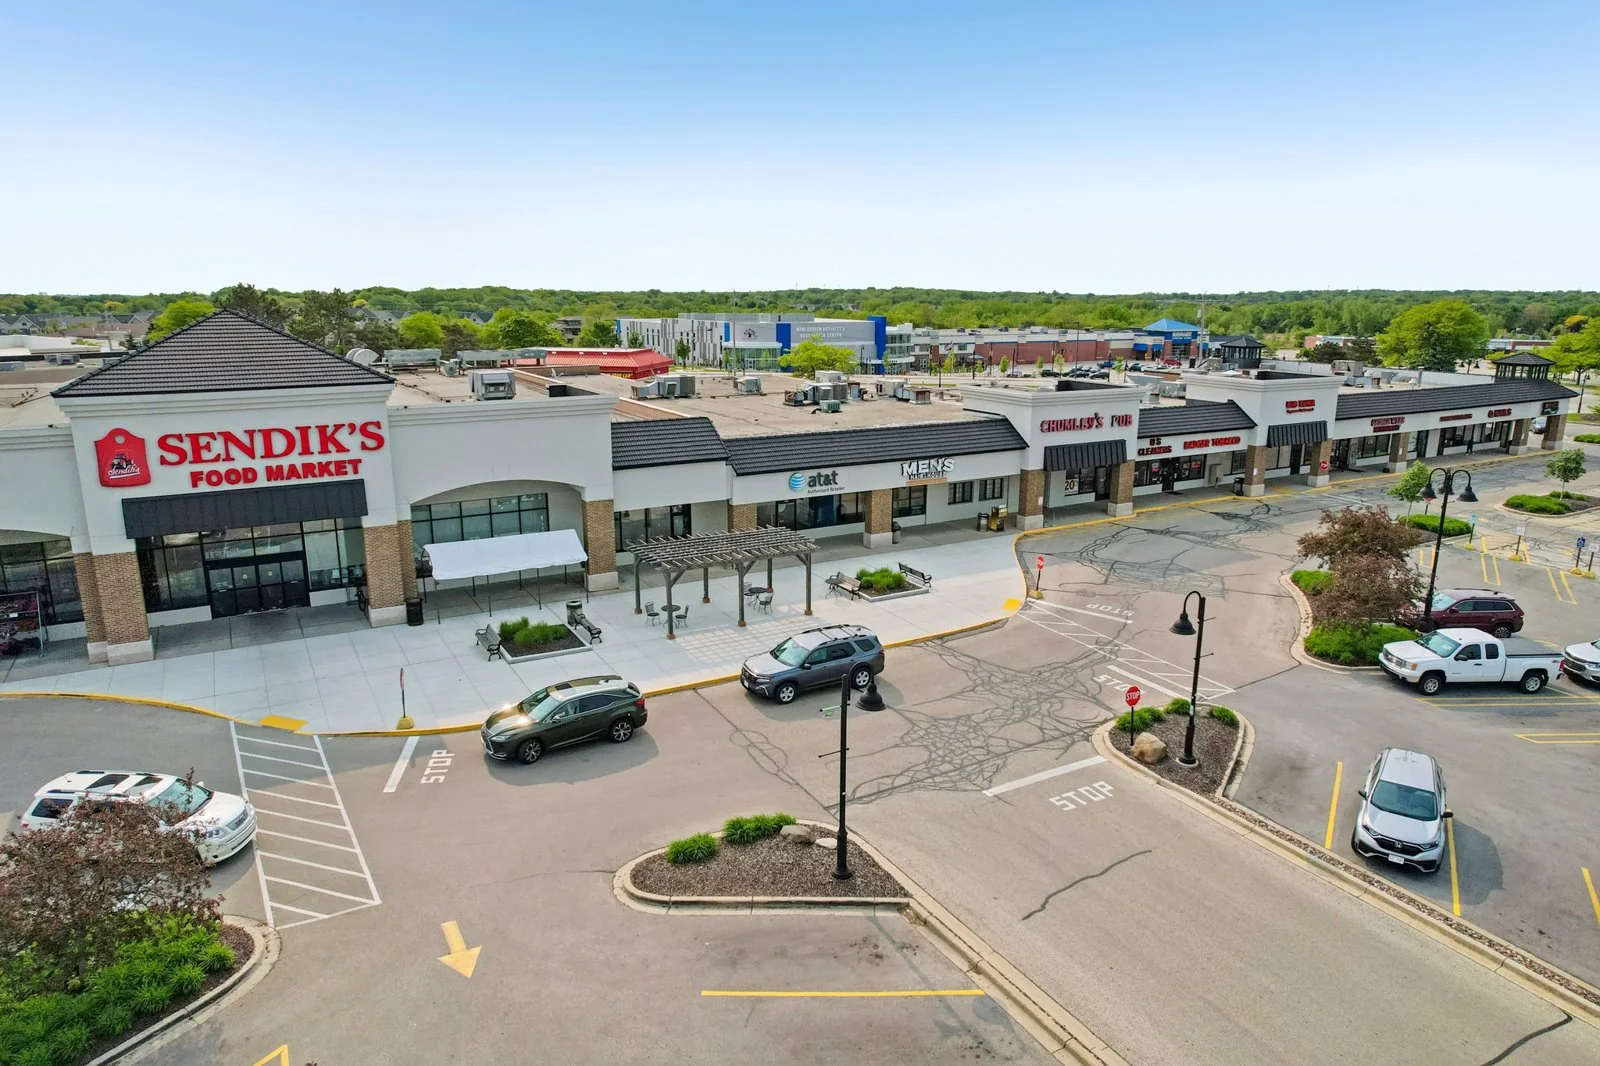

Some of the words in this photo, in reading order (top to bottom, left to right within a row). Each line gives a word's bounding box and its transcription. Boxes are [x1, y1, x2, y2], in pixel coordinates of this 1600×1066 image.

[157, 420, 385, 466] SENDIK'S
[190, 468, 258, 488] FOOD
[266, 459, 363, 482] MARKET
[1126, 691, 1140, 701] STOP
[420, 749, 456, 784] STOP
[1048, 780, 1115, 811] STOP
